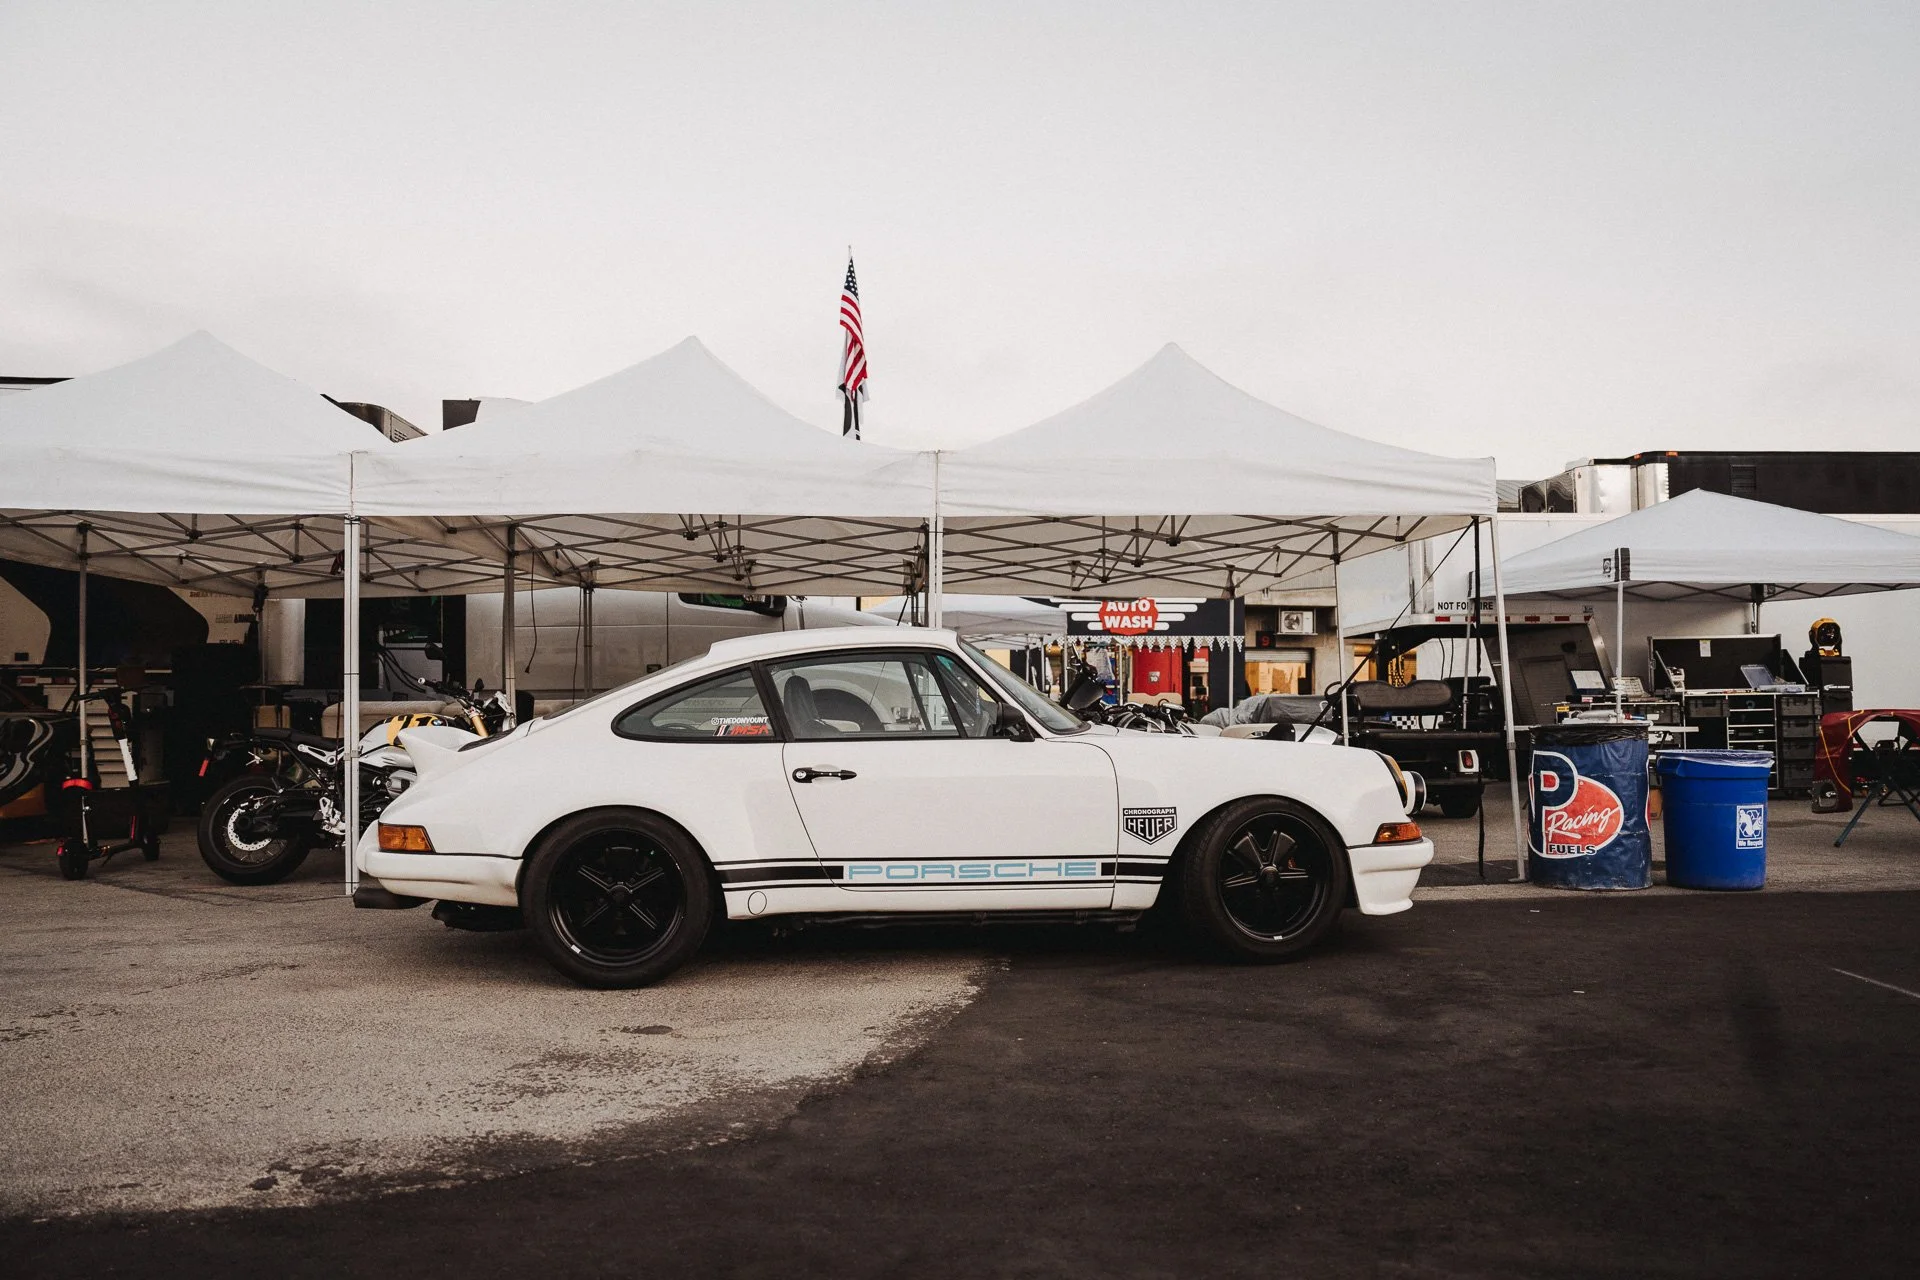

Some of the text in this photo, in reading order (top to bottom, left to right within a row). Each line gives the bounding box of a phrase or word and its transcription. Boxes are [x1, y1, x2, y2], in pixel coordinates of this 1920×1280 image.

[1105, 599, 1151, 612] AUTO
[1437, 601, 1453, 610] NOT
[1480, 601, 1494, 610] IRE
[1104, 615, 1153, 629] WASH
[1261, 636, 1270, 646] 9
[730, 725, 769, 736] IMSA
[1127, 817, 1174, 840] HEUER
[1547, 805, 1620, 842] Racing
[1549, 844, 1596, 855] FUELS
[848, 861, 1097, 880] PORSCHE
